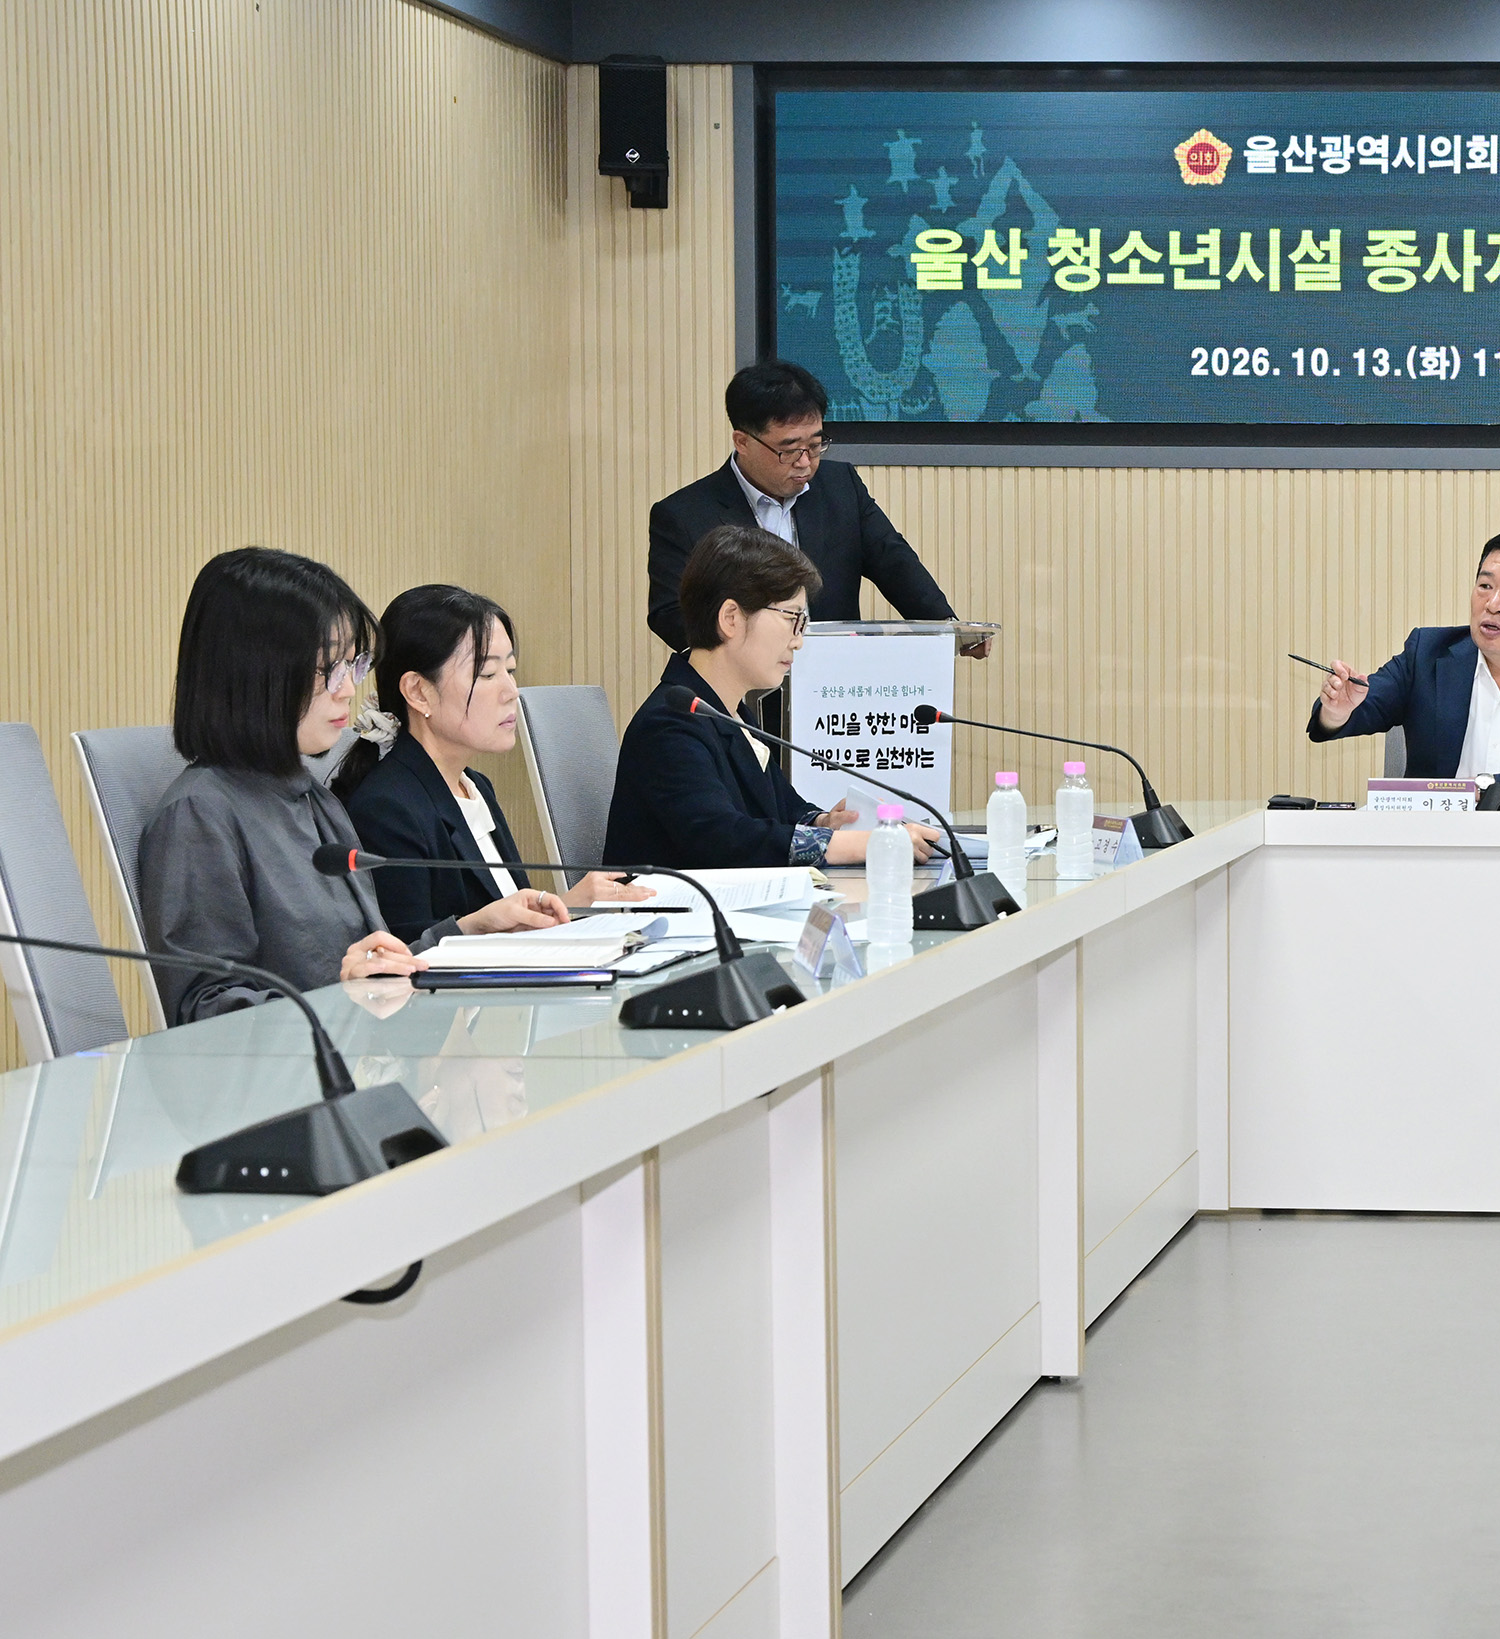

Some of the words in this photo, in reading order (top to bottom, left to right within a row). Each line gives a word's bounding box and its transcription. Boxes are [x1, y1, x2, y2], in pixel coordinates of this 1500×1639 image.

[1188, 150, 1218, 166] 의회
[1244, 134, 1497, 175] 울산광역시의회
[910, 227, 1028, 292] 울산
[1046, 228, 1343, 292] 청소년시설
[1191, 347, 1280, 377] 2026.
[1291, 347, 1340, 377] 10.
[1352, 345, 1461, 381] 13.(화)
[820, 686, 845, 698] 울산을
[848, 686, 872, 698] 새롭게
[875, 685, 899, 697] 시민을
[901, 685, 925, 697] 힘나게
[815, 712, 861, 736] 시민을
[865, 711, 896, 736] 향한
[875, 746, 935, 770] 실천하는
